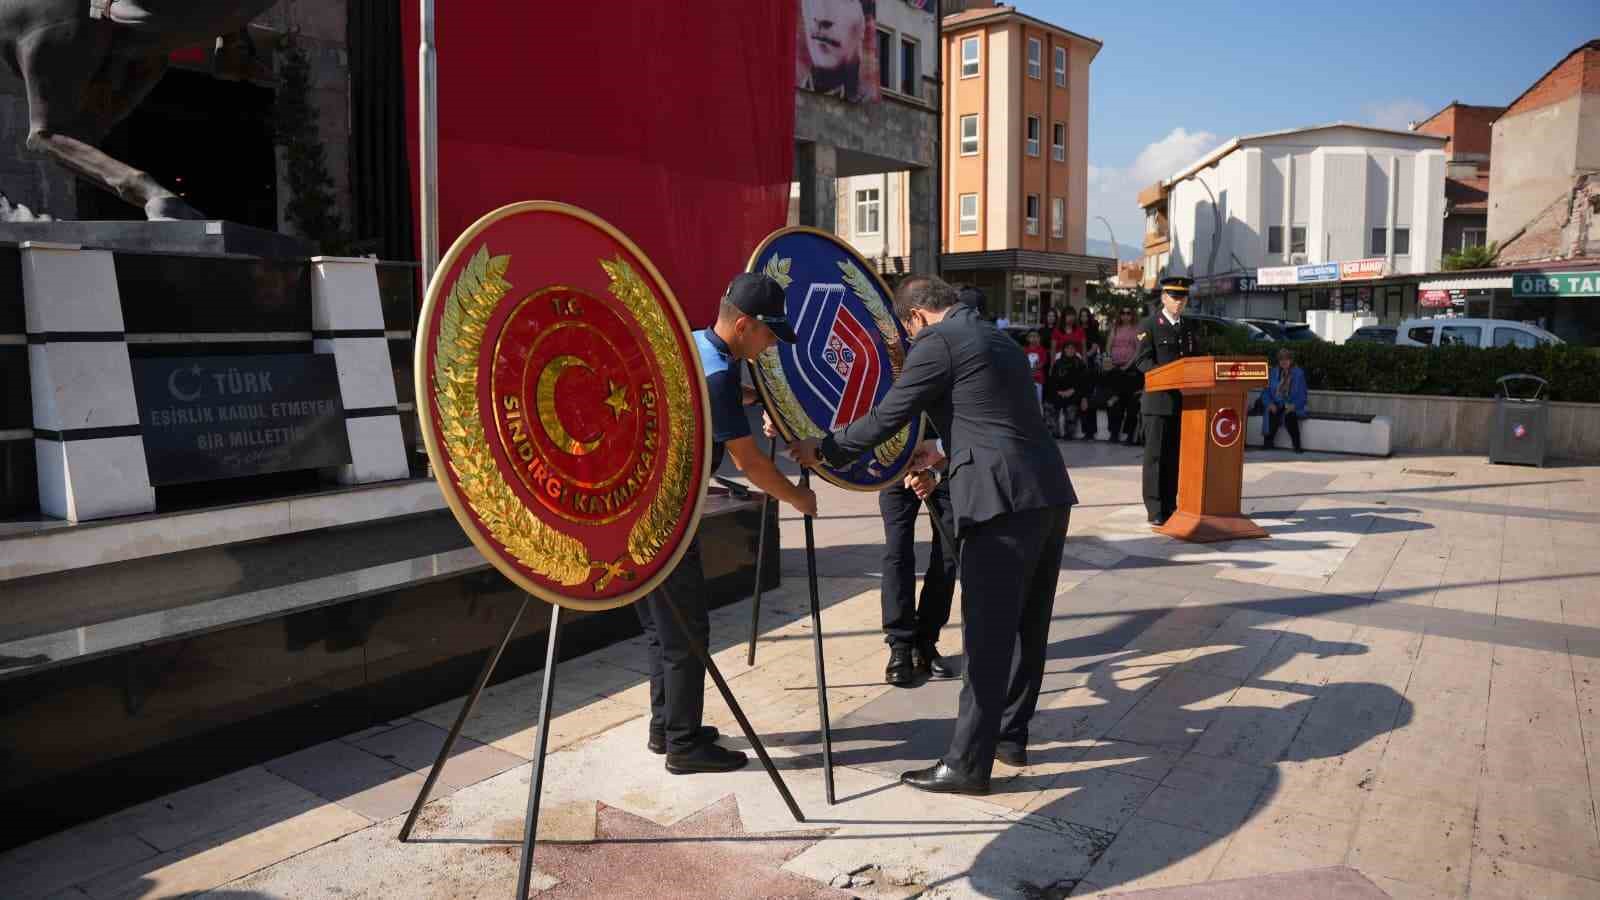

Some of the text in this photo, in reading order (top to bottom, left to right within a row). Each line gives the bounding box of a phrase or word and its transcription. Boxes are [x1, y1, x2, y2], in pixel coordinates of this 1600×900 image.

[1521, 276, 1560, 293] ÖRS
[210, 368, 272, 395] TÜRK
[271, 399, 336, 418] ETMEYEN
[197, 431, 224, 450] BİR
[503, 395, 567, 505] SINDIRGI
